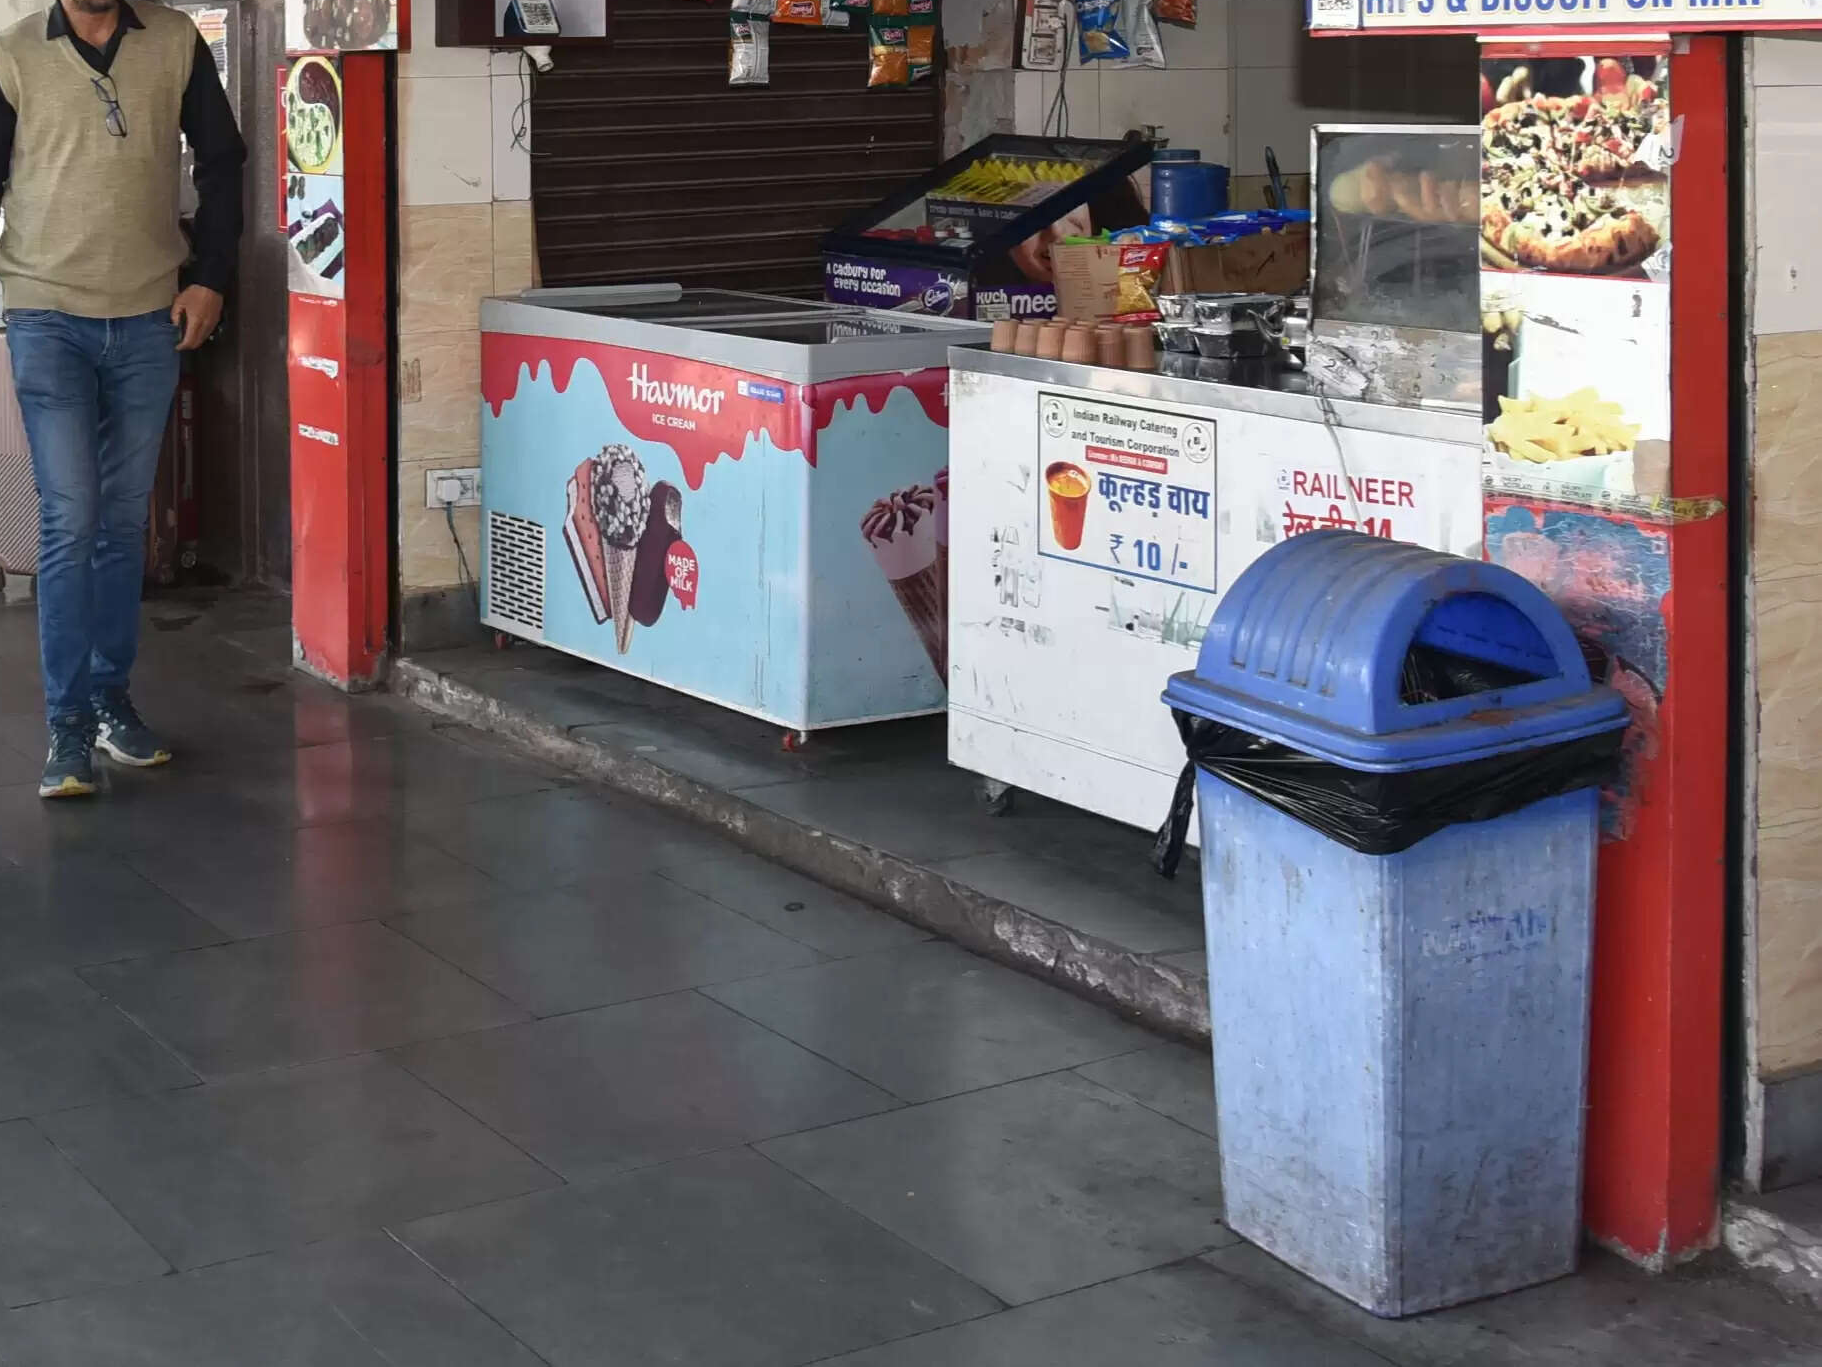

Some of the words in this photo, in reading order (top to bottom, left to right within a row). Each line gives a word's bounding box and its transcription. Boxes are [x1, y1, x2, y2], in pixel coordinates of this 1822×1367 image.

[626, 362, 725, 415] Havmor
[652, 413, 665, 425] ICE
[667, 415, 696, 431] CREAM
[1073, 408, 1100, 422] Indian
[1102, 413, 1138, 431] Railway
[1140, 420, 1178, 438] Catering
[1071, 431, 1087, 441] and
[1089, 432, 1124, 448] Tourism
[1127, 438, 1179, 457] Corporation
[1167, 484, 1210, 519] चाय
[668, 554, 695, 571] MADE
[1133, 539, 1161, 571] 10
[670, 576, 692, 592] MILK
[675, 566, 689, 577] OF
